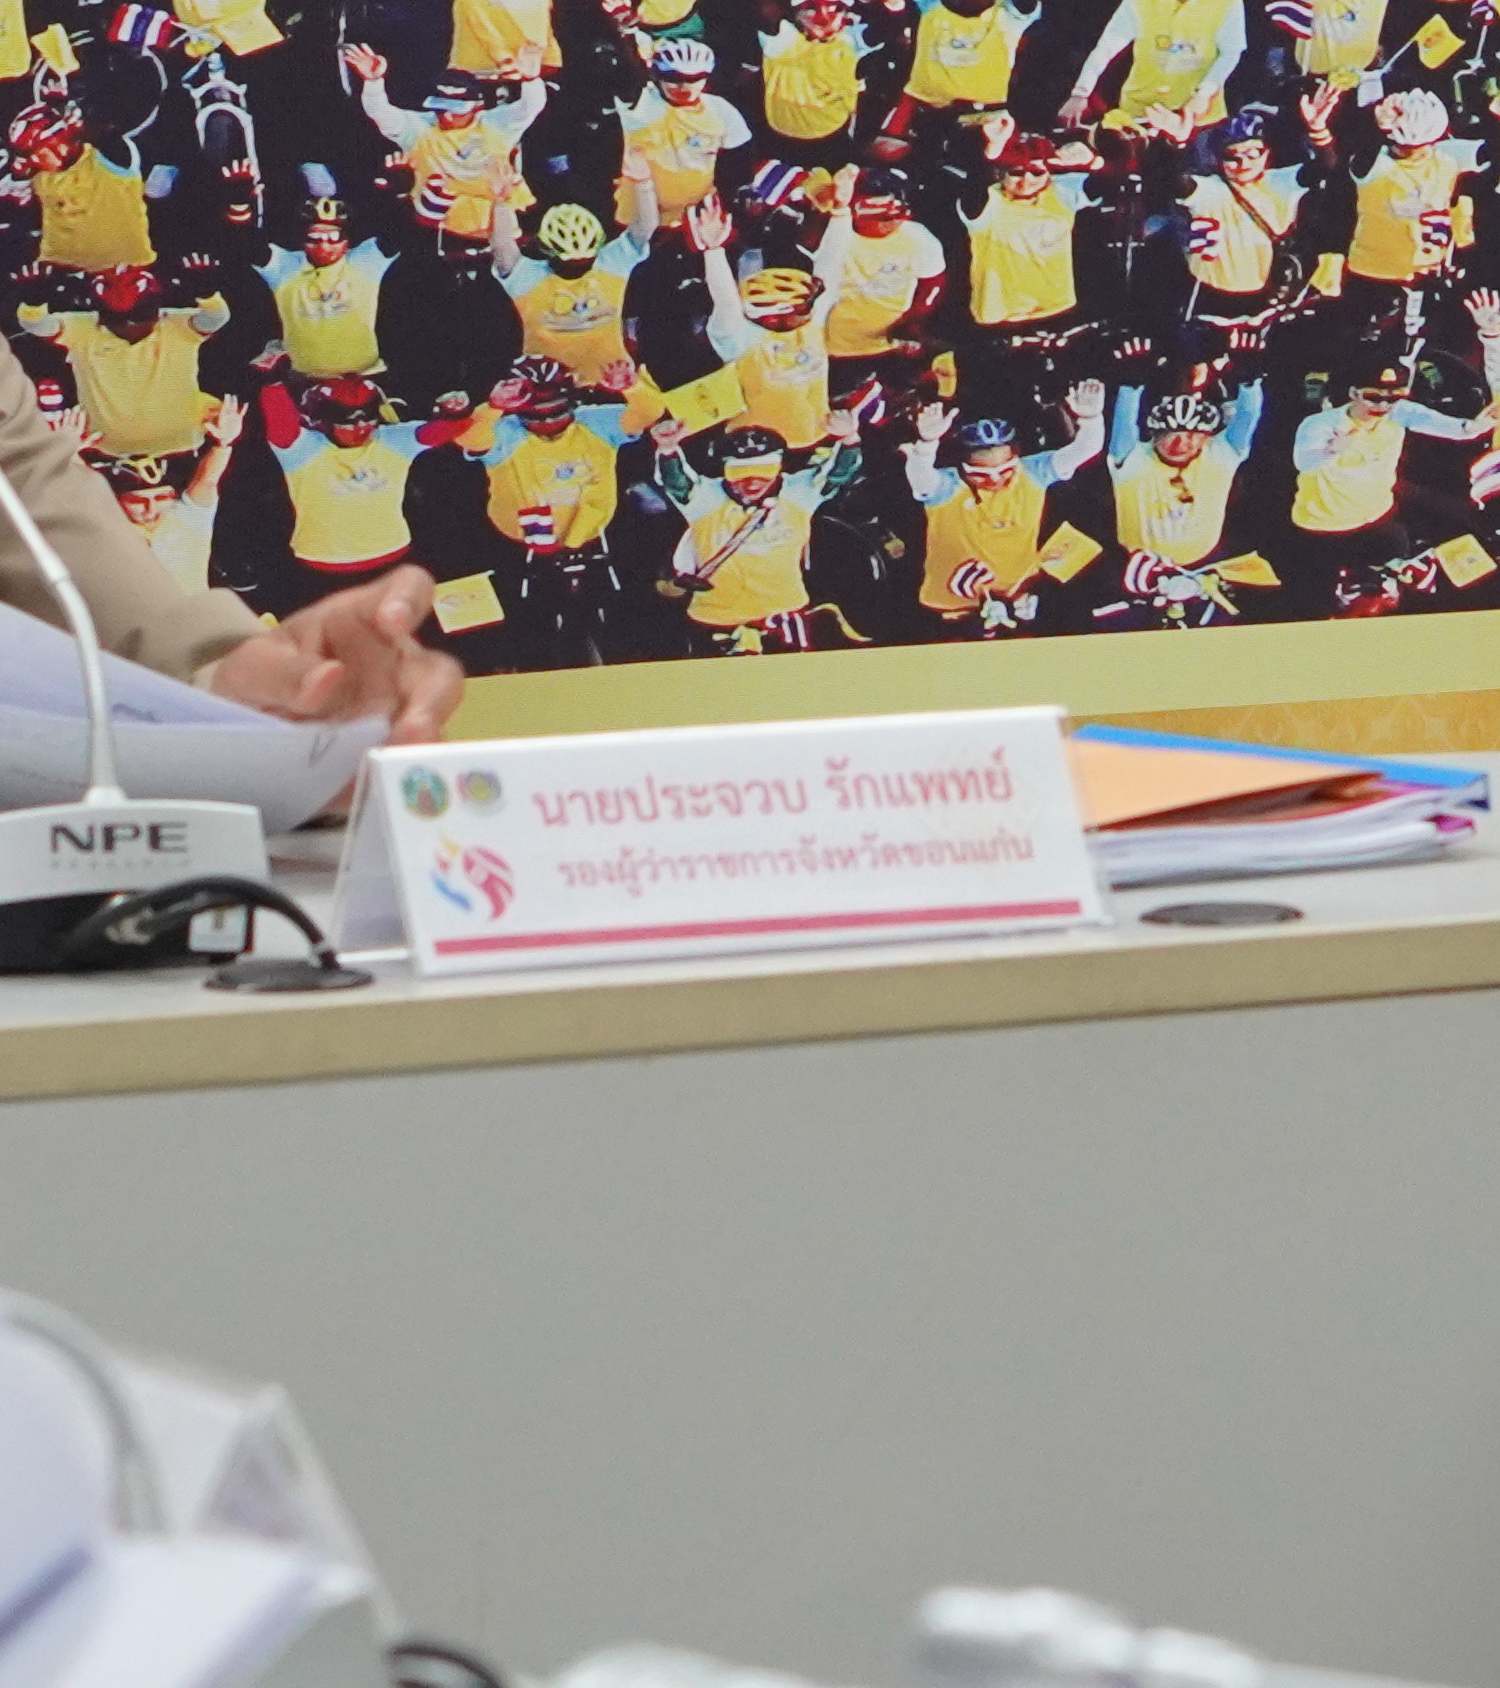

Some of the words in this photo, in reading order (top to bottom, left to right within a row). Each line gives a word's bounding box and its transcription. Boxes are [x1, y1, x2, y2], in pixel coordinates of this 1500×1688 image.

[531, 773, 811, 828] นายประจวบ
[825, 746, 1017, 815] รักแพทย์
[50, 821, 189, 853] NPE
[557, 825, 1037, 900] รองผู้ว่าราชการจังหวัดขอนแก่น
